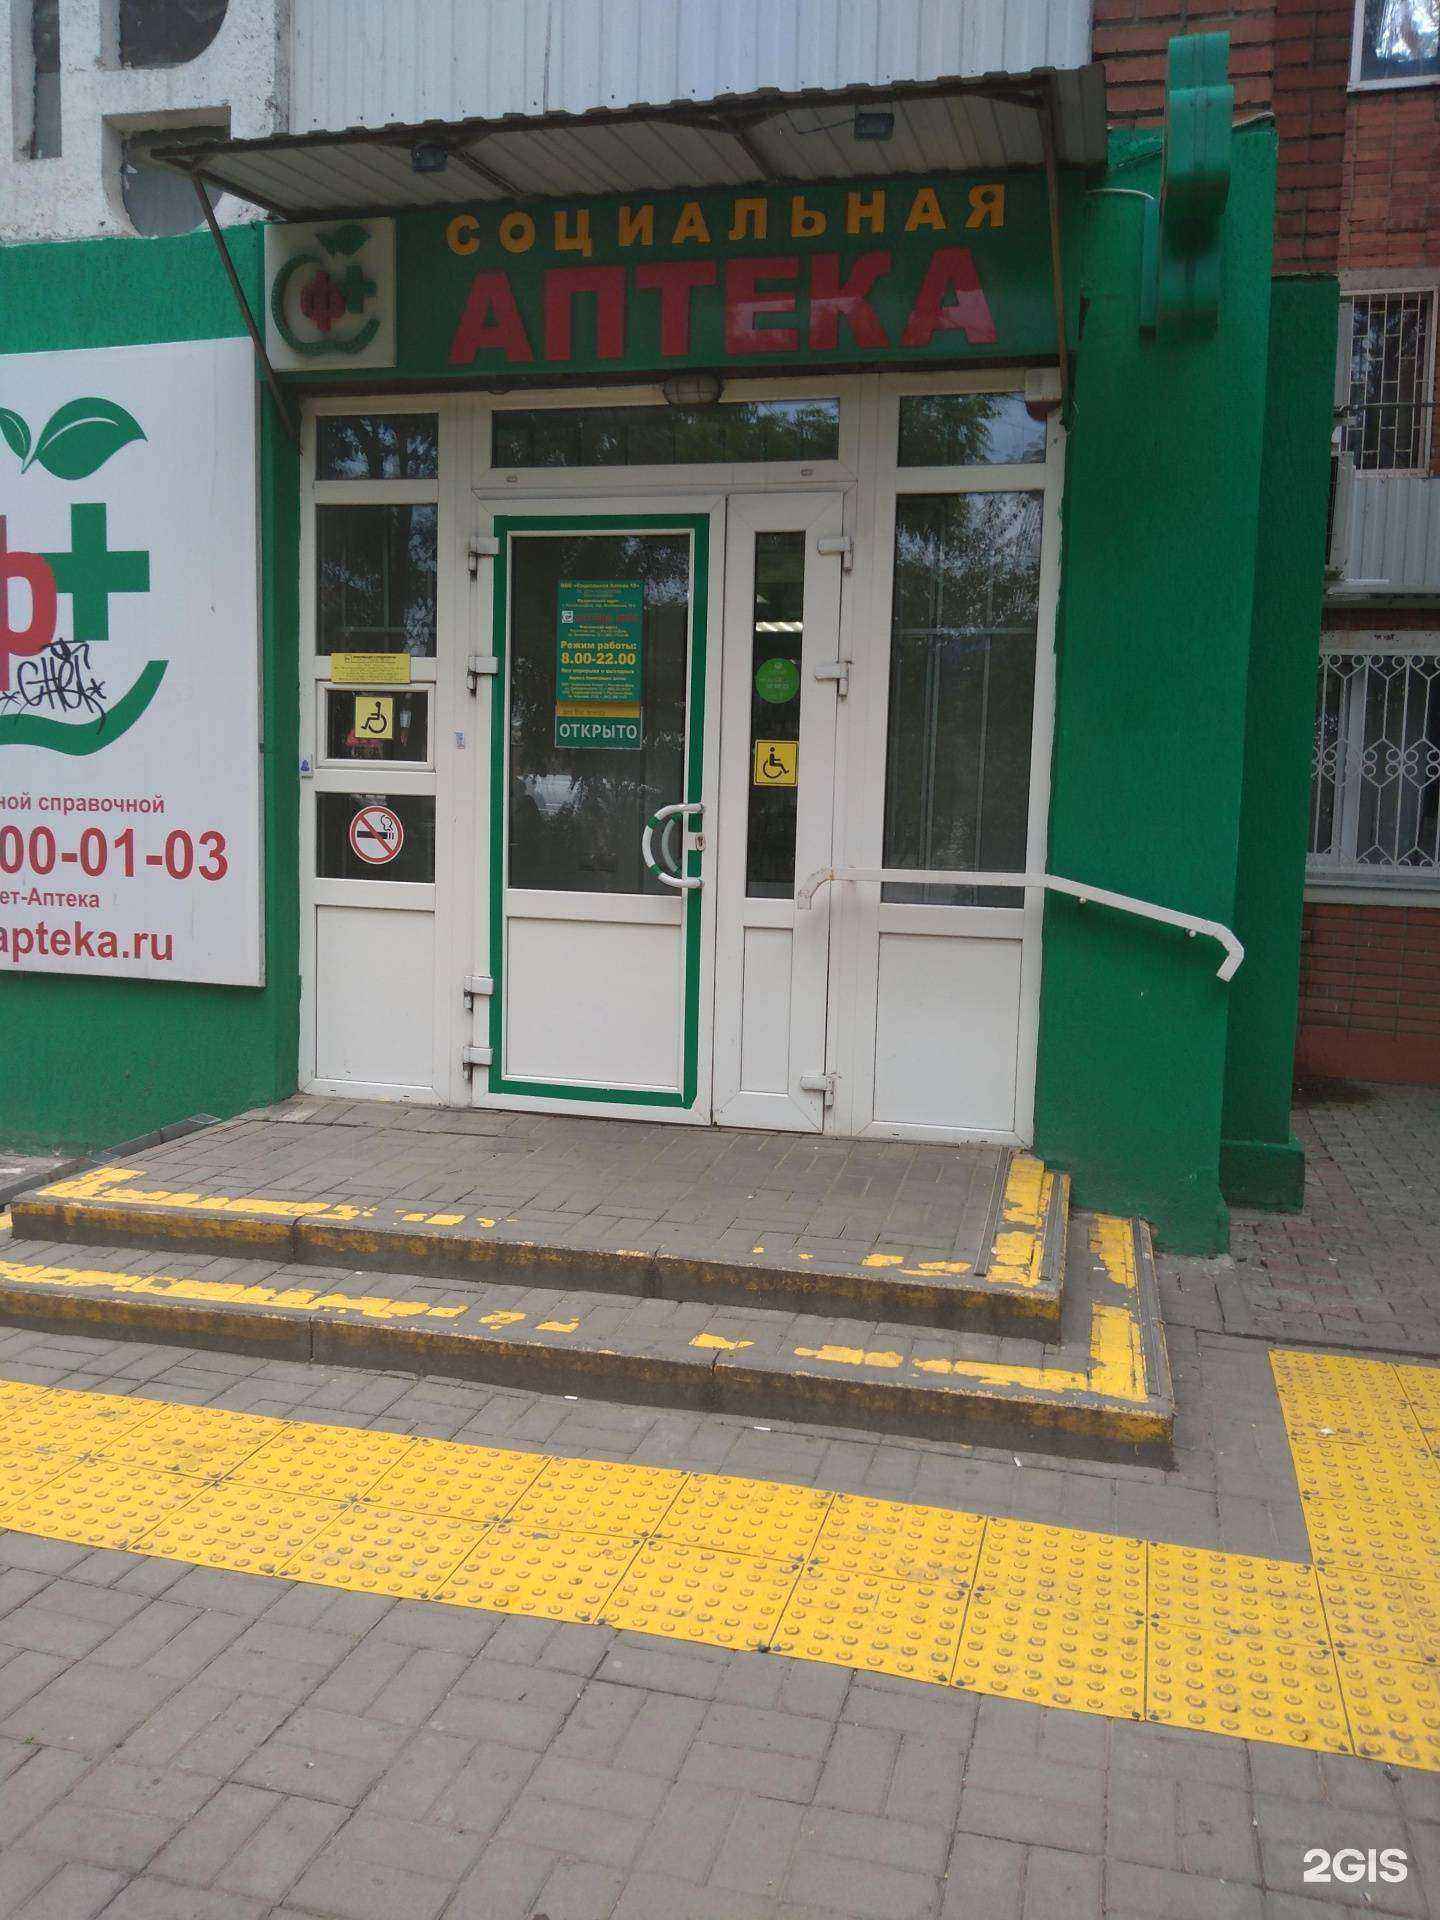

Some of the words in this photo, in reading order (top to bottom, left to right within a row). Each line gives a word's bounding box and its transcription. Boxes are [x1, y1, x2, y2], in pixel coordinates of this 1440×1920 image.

[446, 184, 1006, 257] СОЦИАЛЬНАЯ
[448, 245, 999, 365] АПТЕКА
[560, 640, 595, 649] Режим
[597, 640, 637, 651] работы:
[561, 652, 636, 665] 8.00-22.00
[559, 723, 638, 739] ОТКРЫТО
[0, 792, 31, 811] ой
[38, 794, 165, 816] справочной
[0, 825, 229, 882] 00-01-03
[0, 887, 101, 909] ет-Аптека
